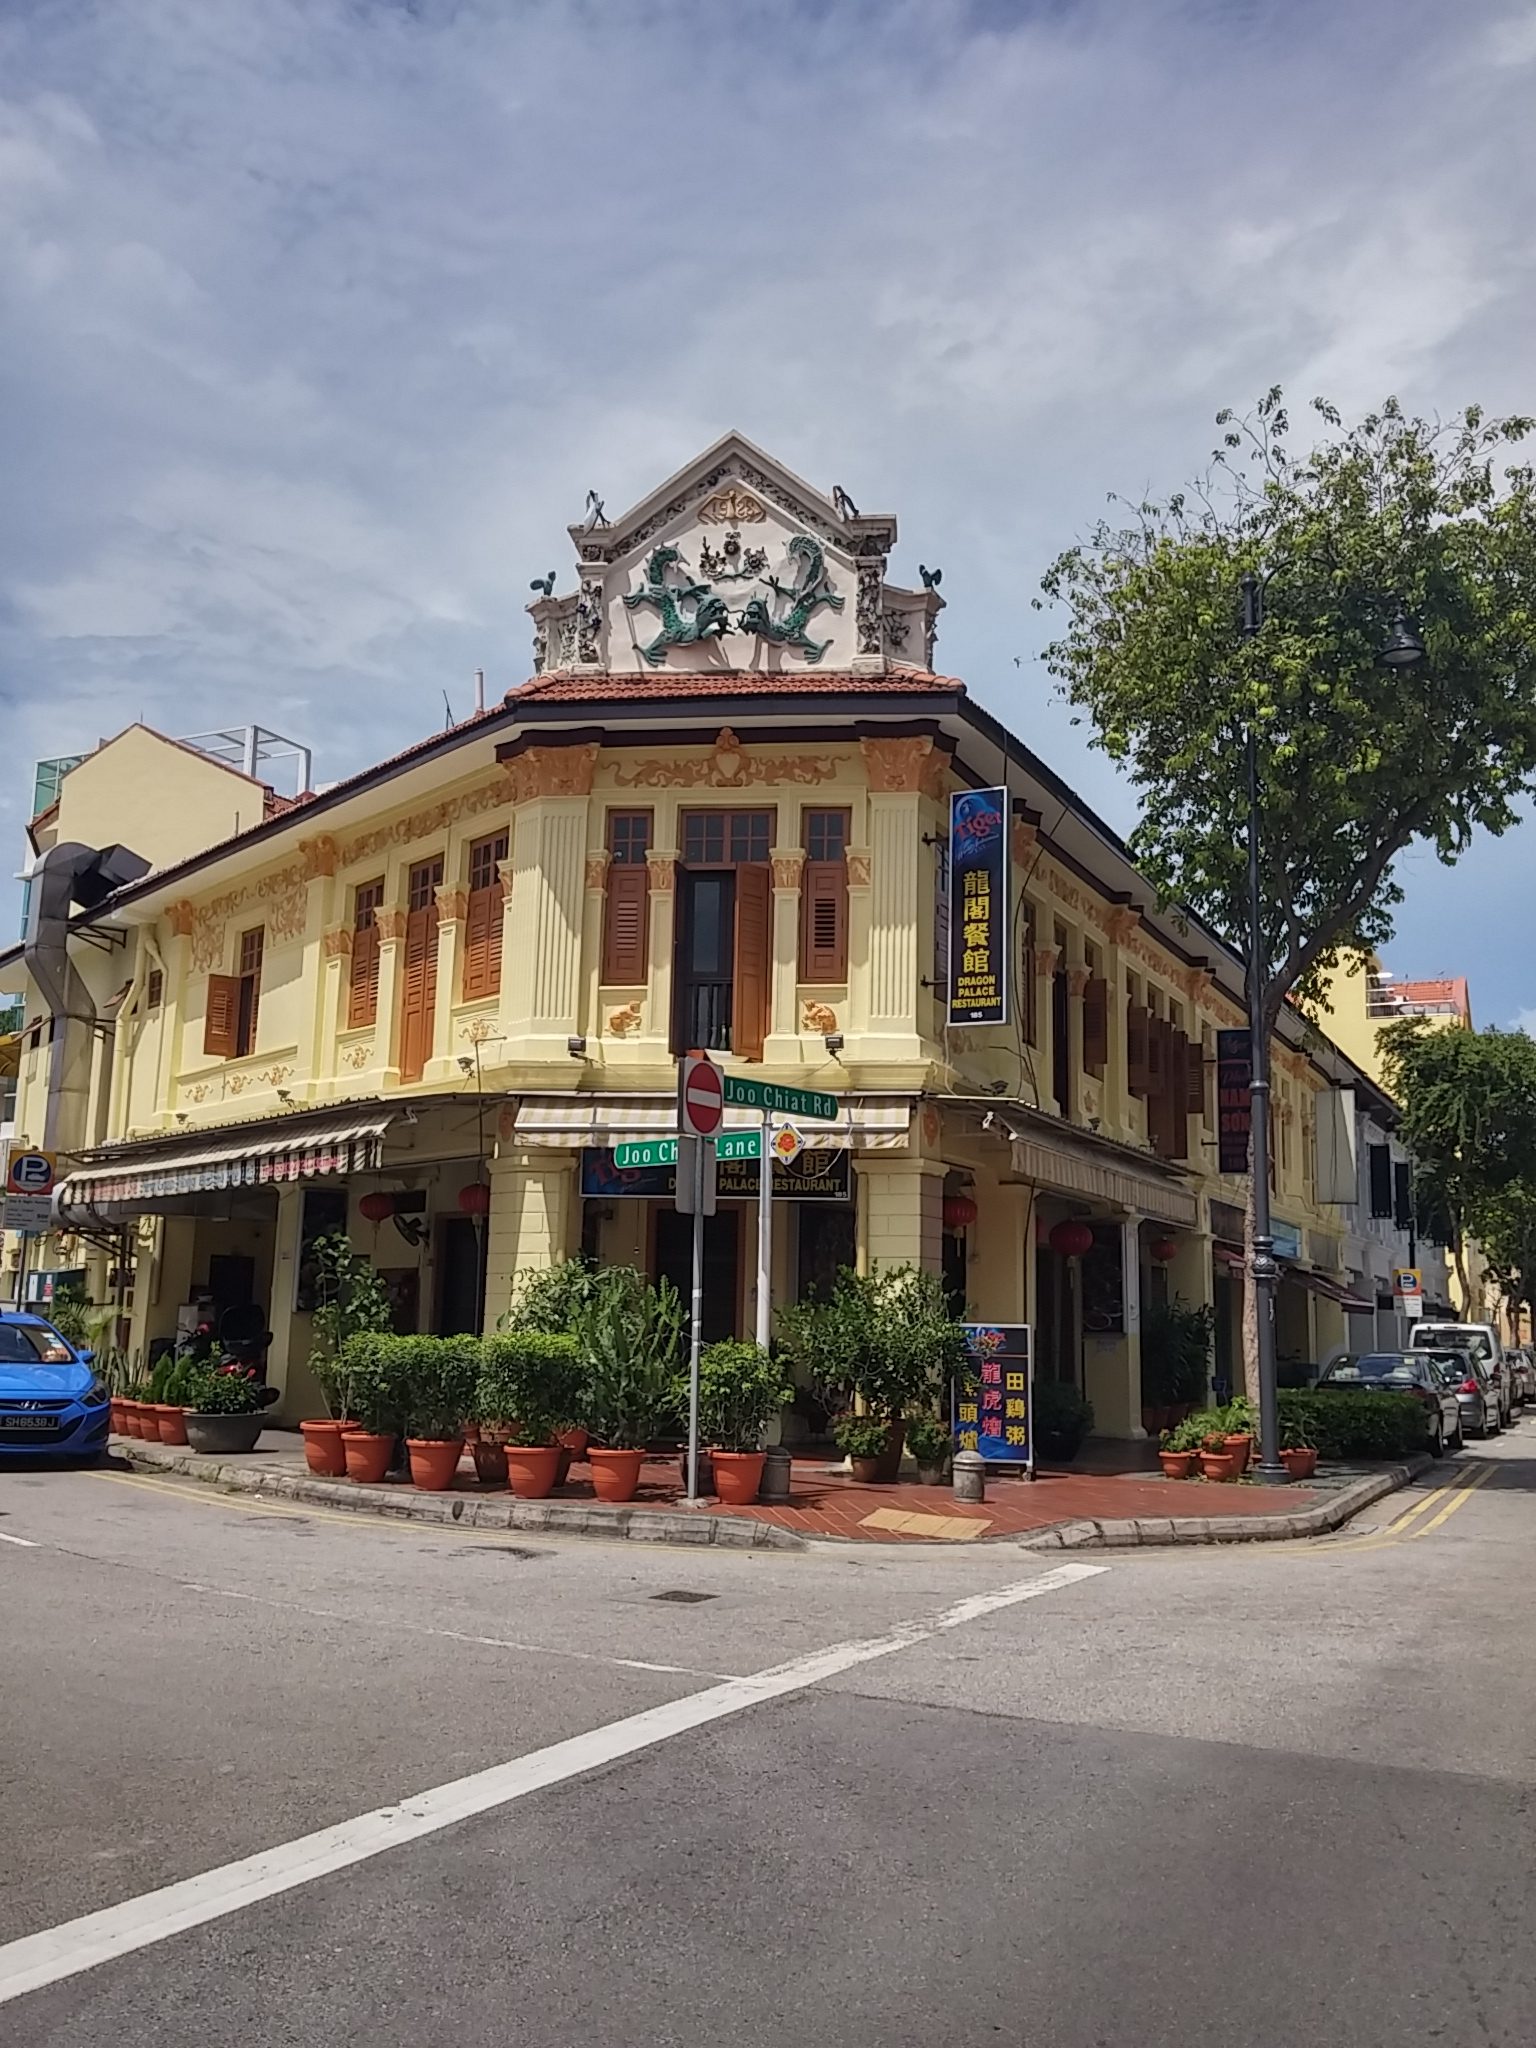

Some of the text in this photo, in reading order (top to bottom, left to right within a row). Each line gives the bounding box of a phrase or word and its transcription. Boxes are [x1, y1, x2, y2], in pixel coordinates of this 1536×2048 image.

[954, 810, 1002, 840] Tiger
[962, 869, 991, 974] 龍閣餐館
[957, 975, 996, 987] DRAGON
[957, 986, 995, 997] PALACE
[951, 997, 1002, 1009] RESTAURANT
[726, 1080, 831, 1116] Joo Chiat Rd
[622, 1145, 651, 1165] Joo
[714, 1138, 756, 1157] Lane
[771, 1178, 842, 1192] ESTAURANT
[5, 1416, 56, 1428] SH6538J
